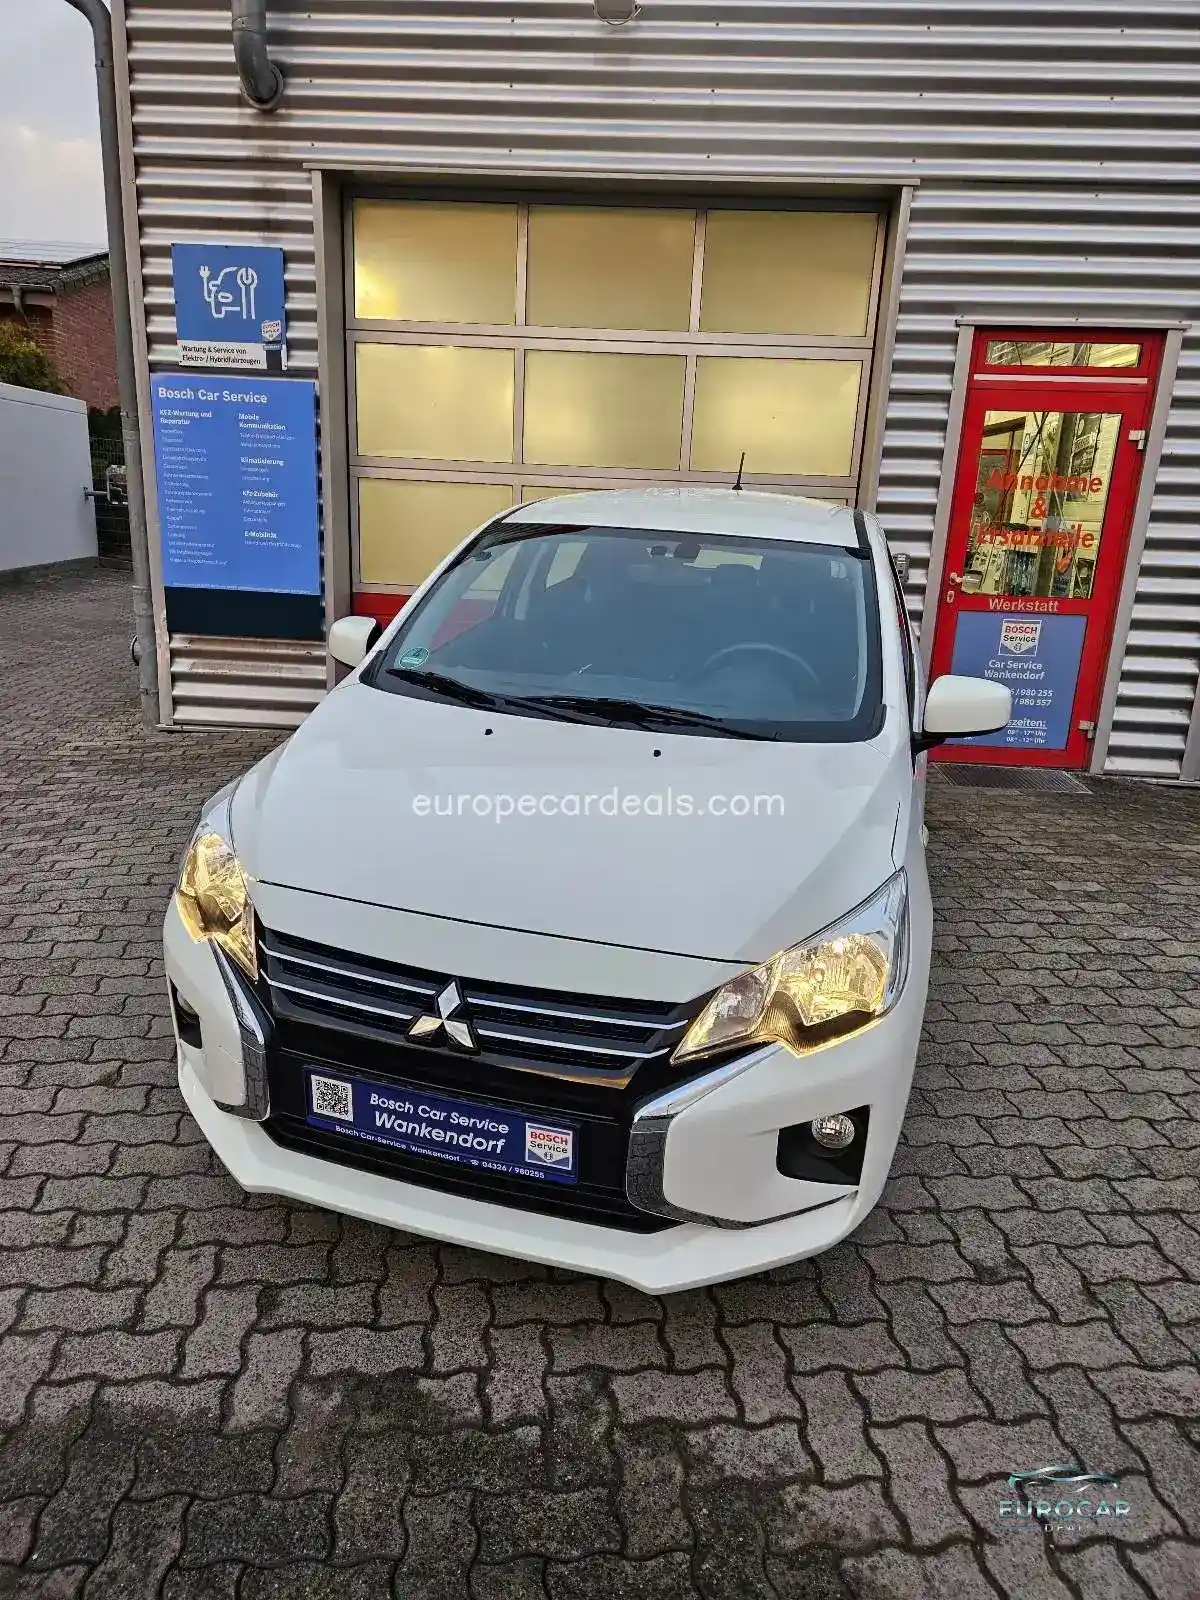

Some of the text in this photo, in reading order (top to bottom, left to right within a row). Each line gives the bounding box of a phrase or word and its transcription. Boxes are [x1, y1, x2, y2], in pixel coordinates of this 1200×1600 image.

[182, 345, 207, 354] Wartung
[213, 346, 235, 354] Service
[209, 355, 261, 365] Hybridfahrzeugen
[158, 387, 268, 403] Bosch Car Service
[1031, 496, 1047, 517] &
[988, 598, 1059, 612] Werkstatt
[1004, 625, 1037, 634] BOSCH
[1003, 634, 1036, 643] Service
[988, 660, 1042, 670] Car Service
[984, 670, 1045, 680] Wankendorf
[1020, 688, 1036, 696] 980
[1037, 689, 1054, 697] 255
[1019, 698, 1035, 706] 980
[1007, 717, 1047, 728] szeiten:
[369, 1093, 510, 1134] Bosch Car Service
[374, 1110, 506, 1154] Wankendorf
[530, 1130, 568, 1146] BOSCH
[335, 1125, 359, 1137] Bosch
[360, 1132, 407, 1150] Car-Service
[410, 1144, 460, 1162] Wankendorf
[482, 1160, 507, 1172] 04326
[514, 1166, 545, 1179] 980255
[529, 1140, 568, 1154] Service
